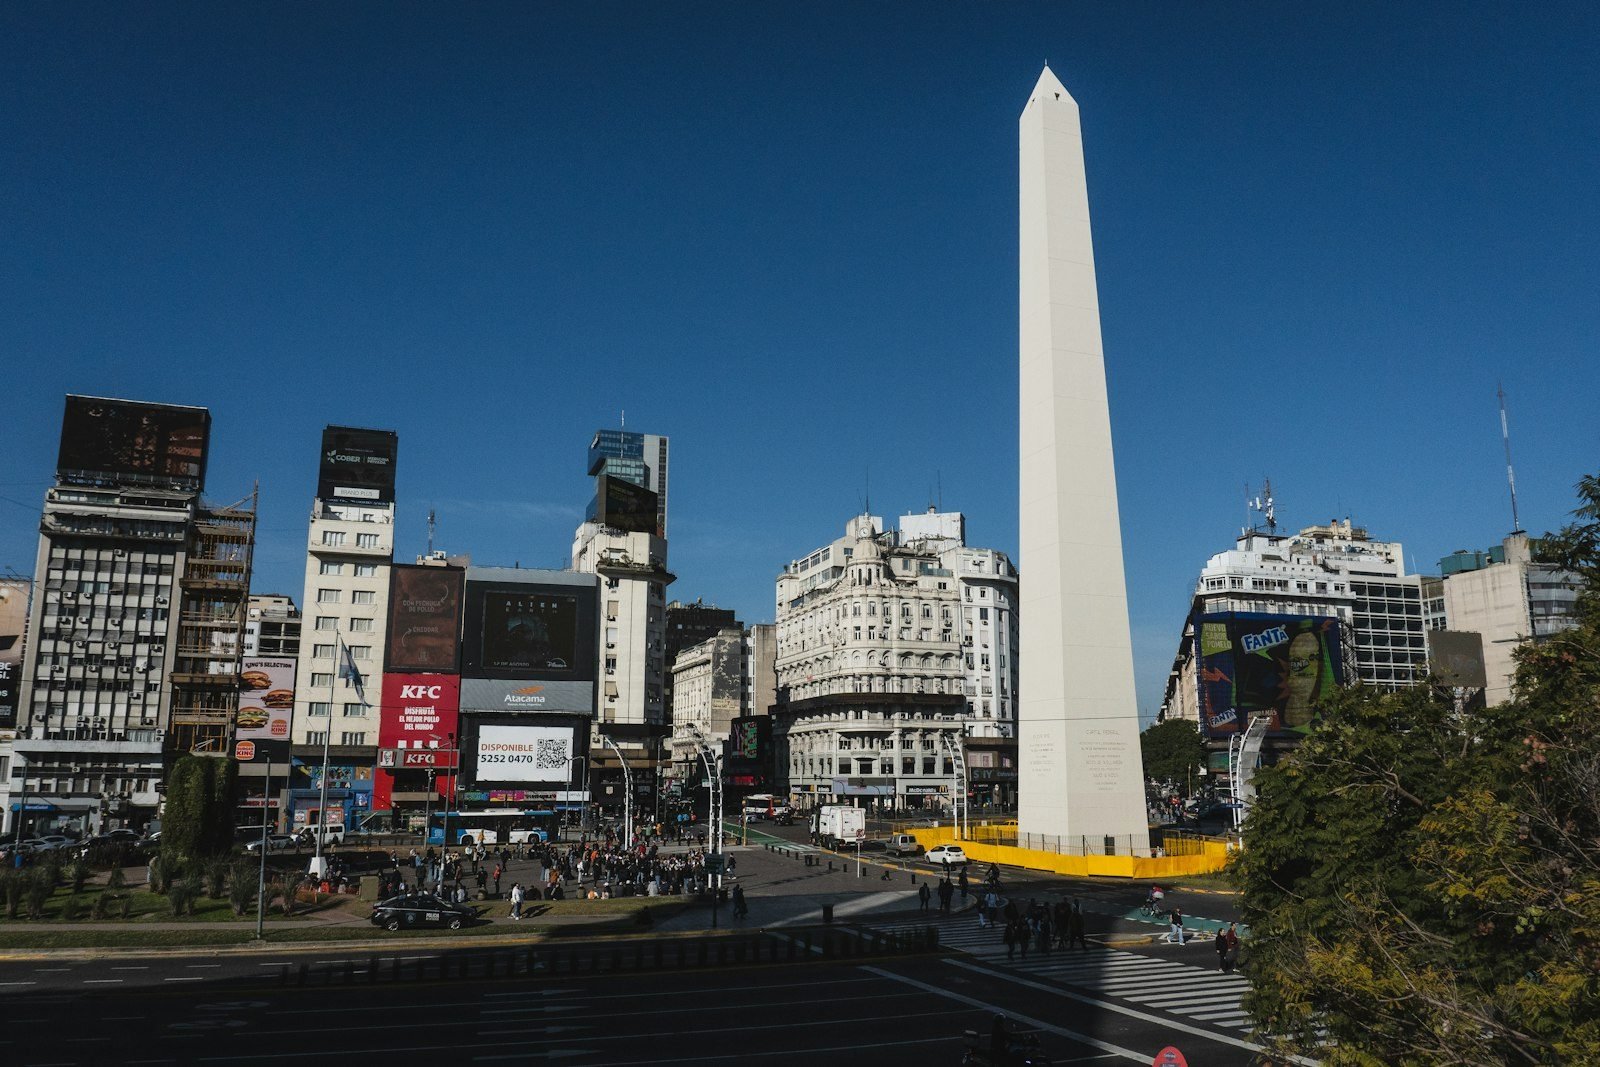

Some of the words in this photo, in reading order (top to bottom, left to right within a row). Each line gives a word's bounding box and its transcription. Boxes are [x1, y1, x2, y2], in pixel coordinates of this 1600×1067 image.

[336, 455, 361, 463] COBER
[1203, 624, 1226, 632] NUEVO
[1206, 632, 1227, 640] SABOR
[1243, 628, 1288, 651] FANTA
[1207, 640, 1232, 649] POMELO
[1290, 659, 1310, 671] FANTA
[400, 685, 441, 699] KFC
[504, 694, 545, 703] Atacama
[405, 706, 435, 715] DISFRUTÁ
[1211, 712, 1236, 726] FANTA
[481, 743, 534, 752] DISPONIBLE
[481, 755, 505, 763] 5252
[508, 755, 533, 763] 0470
